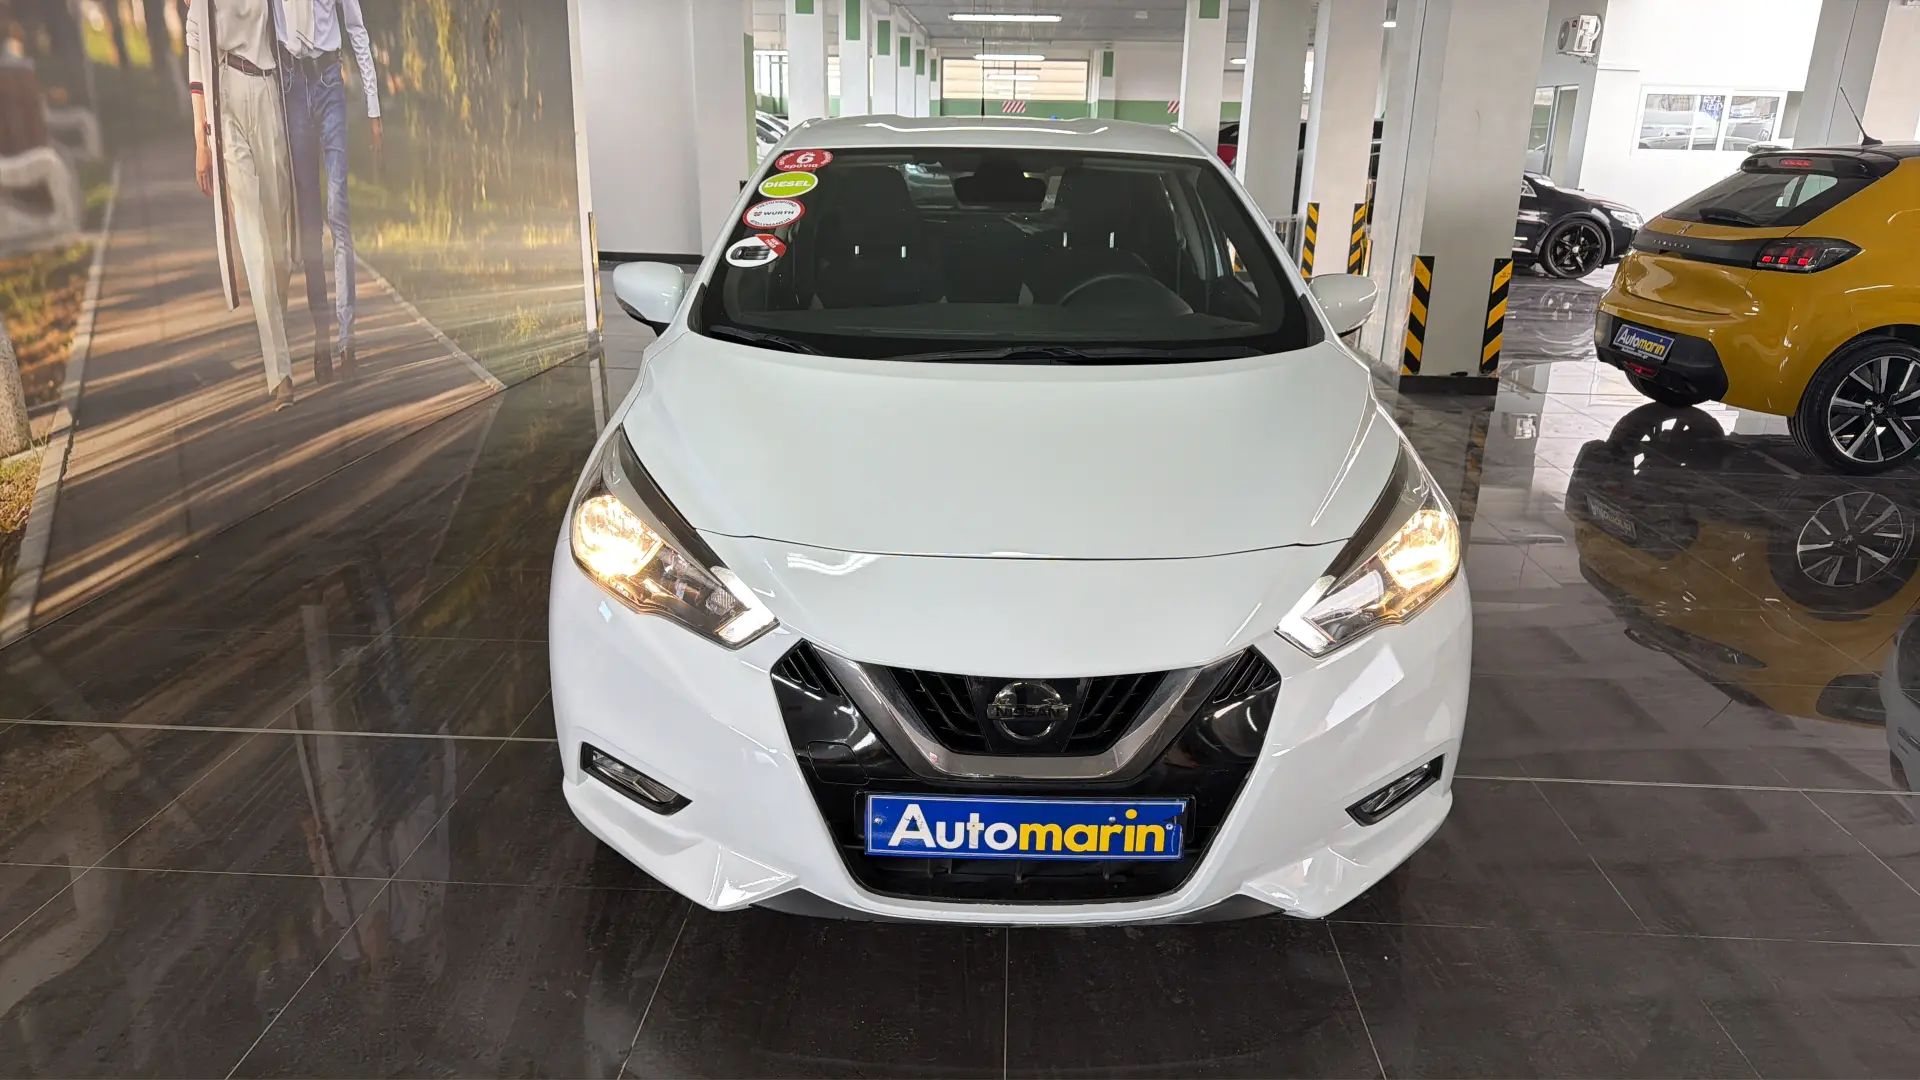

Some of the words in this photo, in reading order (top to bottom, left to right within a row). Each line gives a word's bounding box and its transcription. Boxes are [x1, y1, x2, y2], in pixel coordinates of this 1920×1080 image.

[797, 153, 816, 164] 6
[1617, 328, 1666, 355] Automarin
[996, 706, 1060, 718] NISSAN
[887, 803, 1165, 853] Automarin
